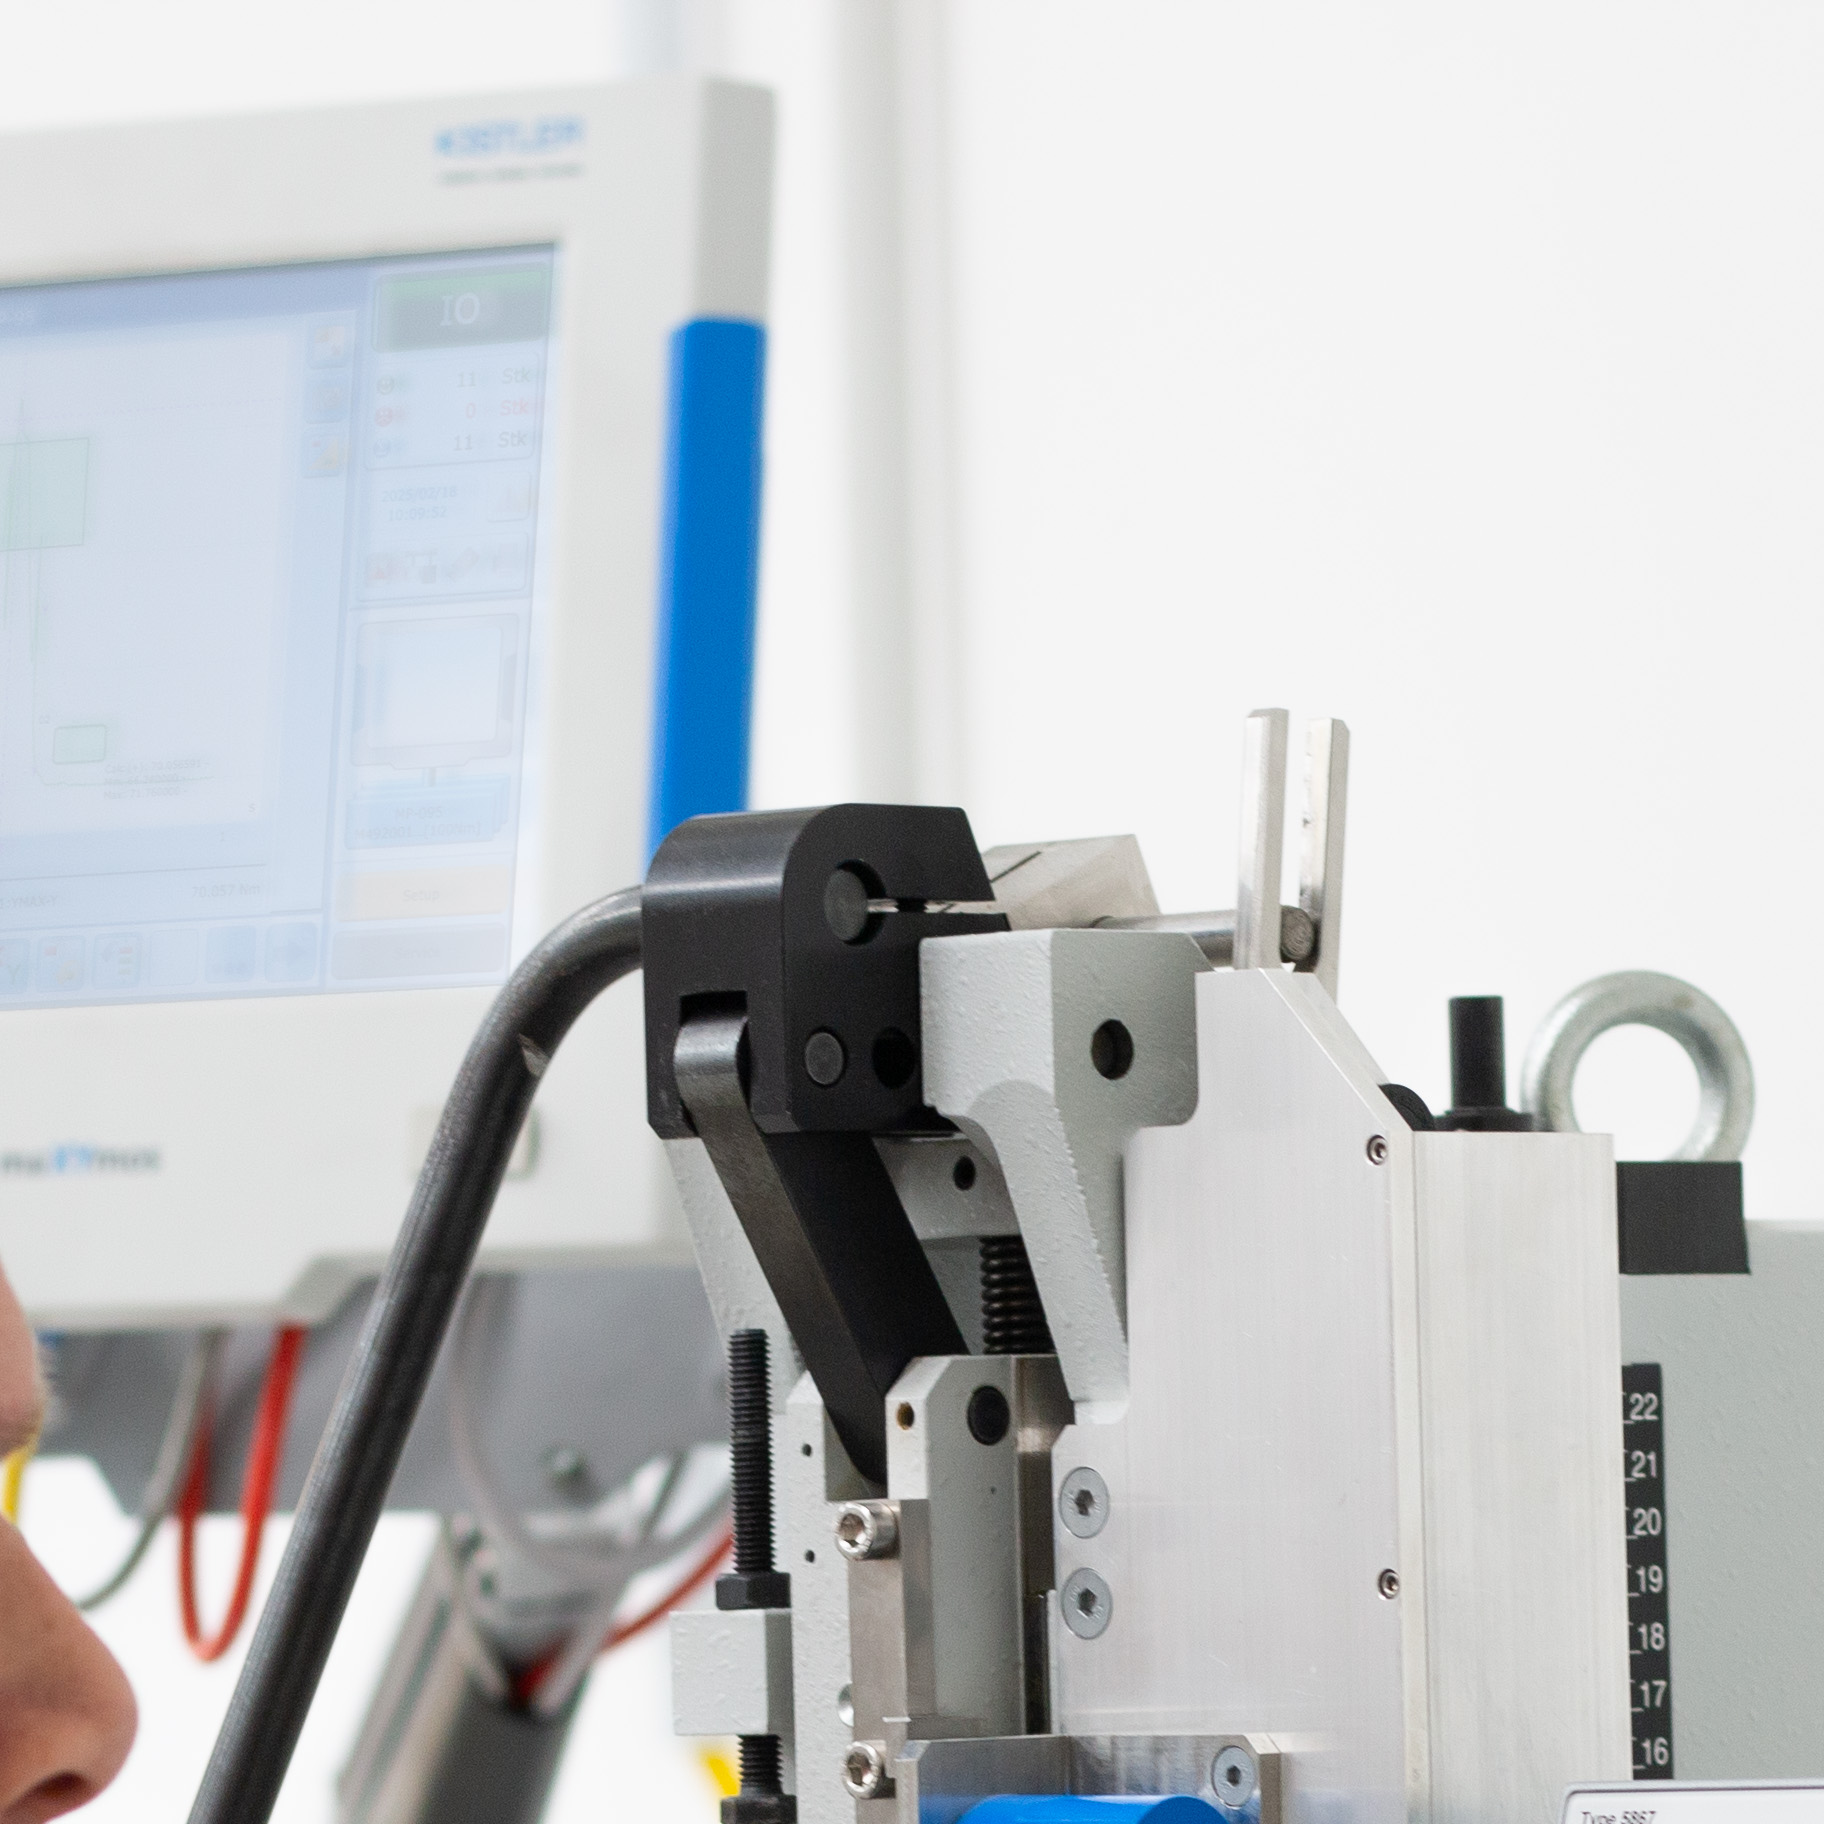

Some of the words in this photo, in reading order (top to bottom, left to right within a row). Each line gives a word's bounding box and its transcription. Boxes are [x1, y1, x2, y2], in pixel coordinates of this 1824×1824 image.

[440, 293, 481, 326] IO
[458, 372, 477, 388] 11
[501, 367, 532, 384] Stk
[465, 402, 477, 419] 0
[499, 399, 530, 416] Stk
[454, 434, 474, 451] 11
[497, 431, 527, 448] Stk
[1630, 1392, 1659, 1421] 22
[1631, 1450, 1657, 1479] 21
[1633, 1507, 1662, 1536] 20
[1635, 1565, 1664, 1593] 19
[1638, 1622, 1665, 1651] 18
[1640, 1680, 1668, 1708] 17
[1642, 1737, 1669, 1766] 16
